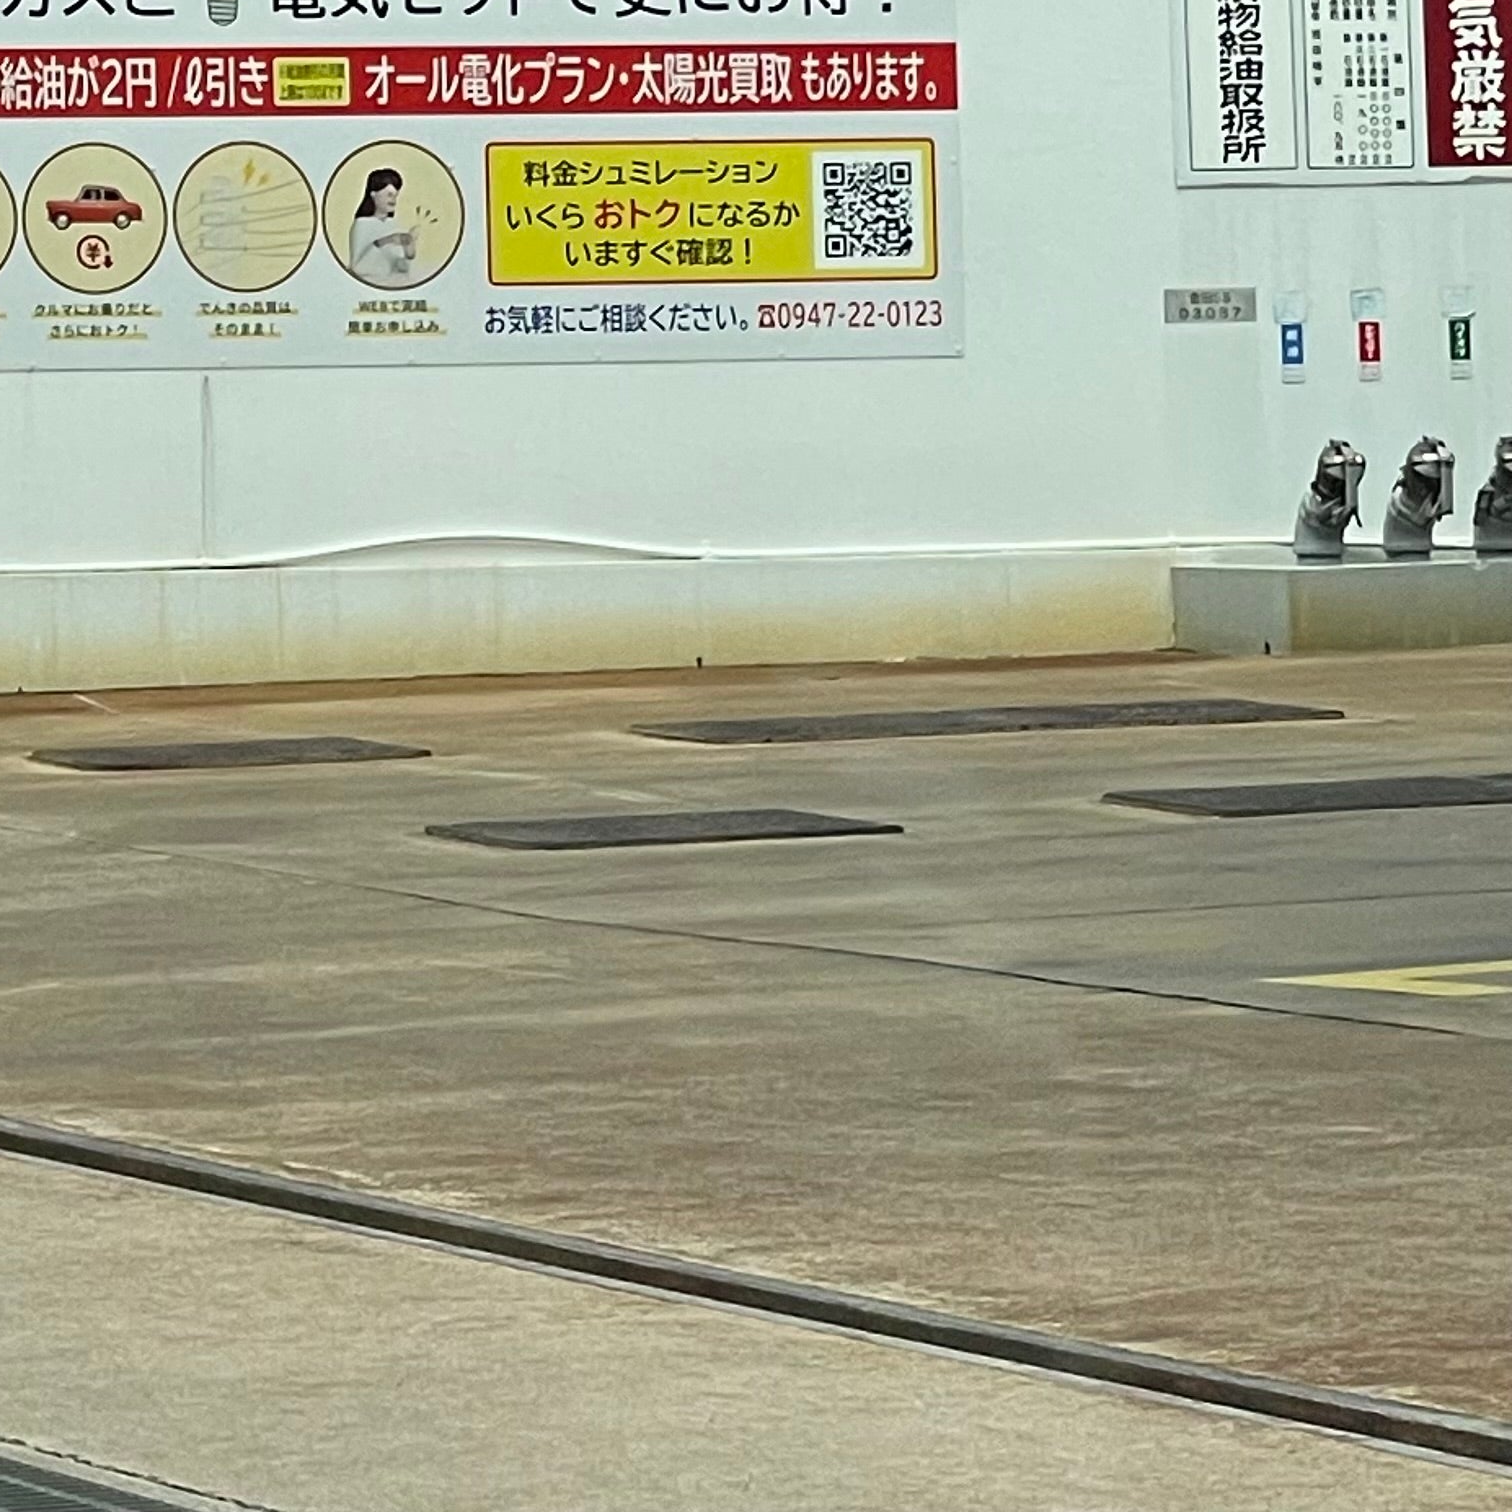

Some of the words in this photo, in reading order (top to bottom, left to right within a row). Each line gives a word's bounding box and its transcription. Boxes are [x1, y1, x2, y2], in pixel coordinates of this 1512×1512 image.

[523, 159, 779, 188] 料金シュミレーション
